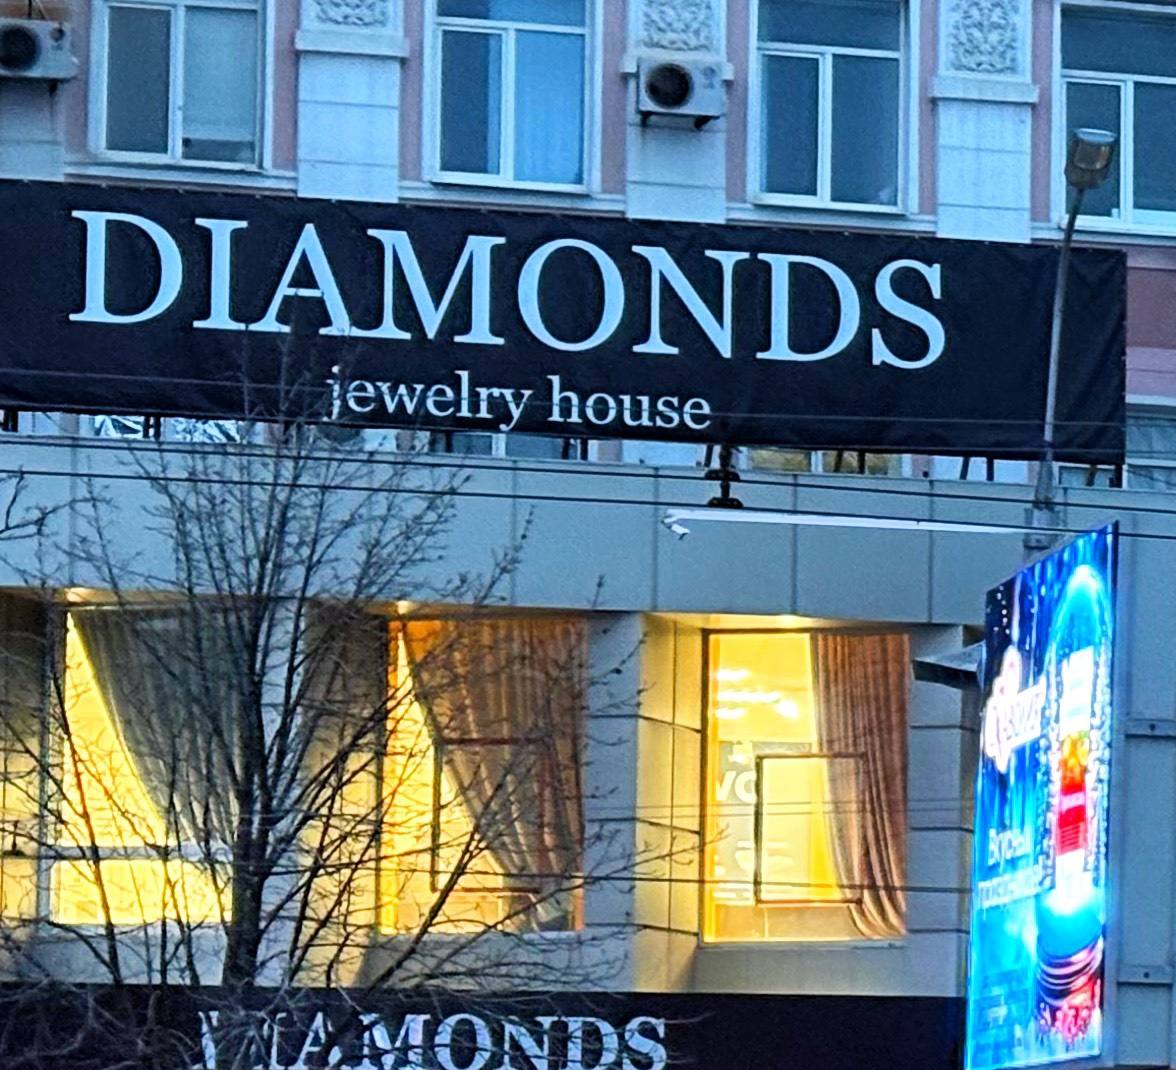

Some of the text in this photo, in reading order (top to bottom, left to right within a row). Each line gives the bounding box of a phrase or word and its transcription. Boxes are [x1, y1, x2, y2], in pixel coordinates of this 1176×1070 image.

[69, 208, 949, 370] DIAMONDS
[323, 364, 712, 432] jewelry house
